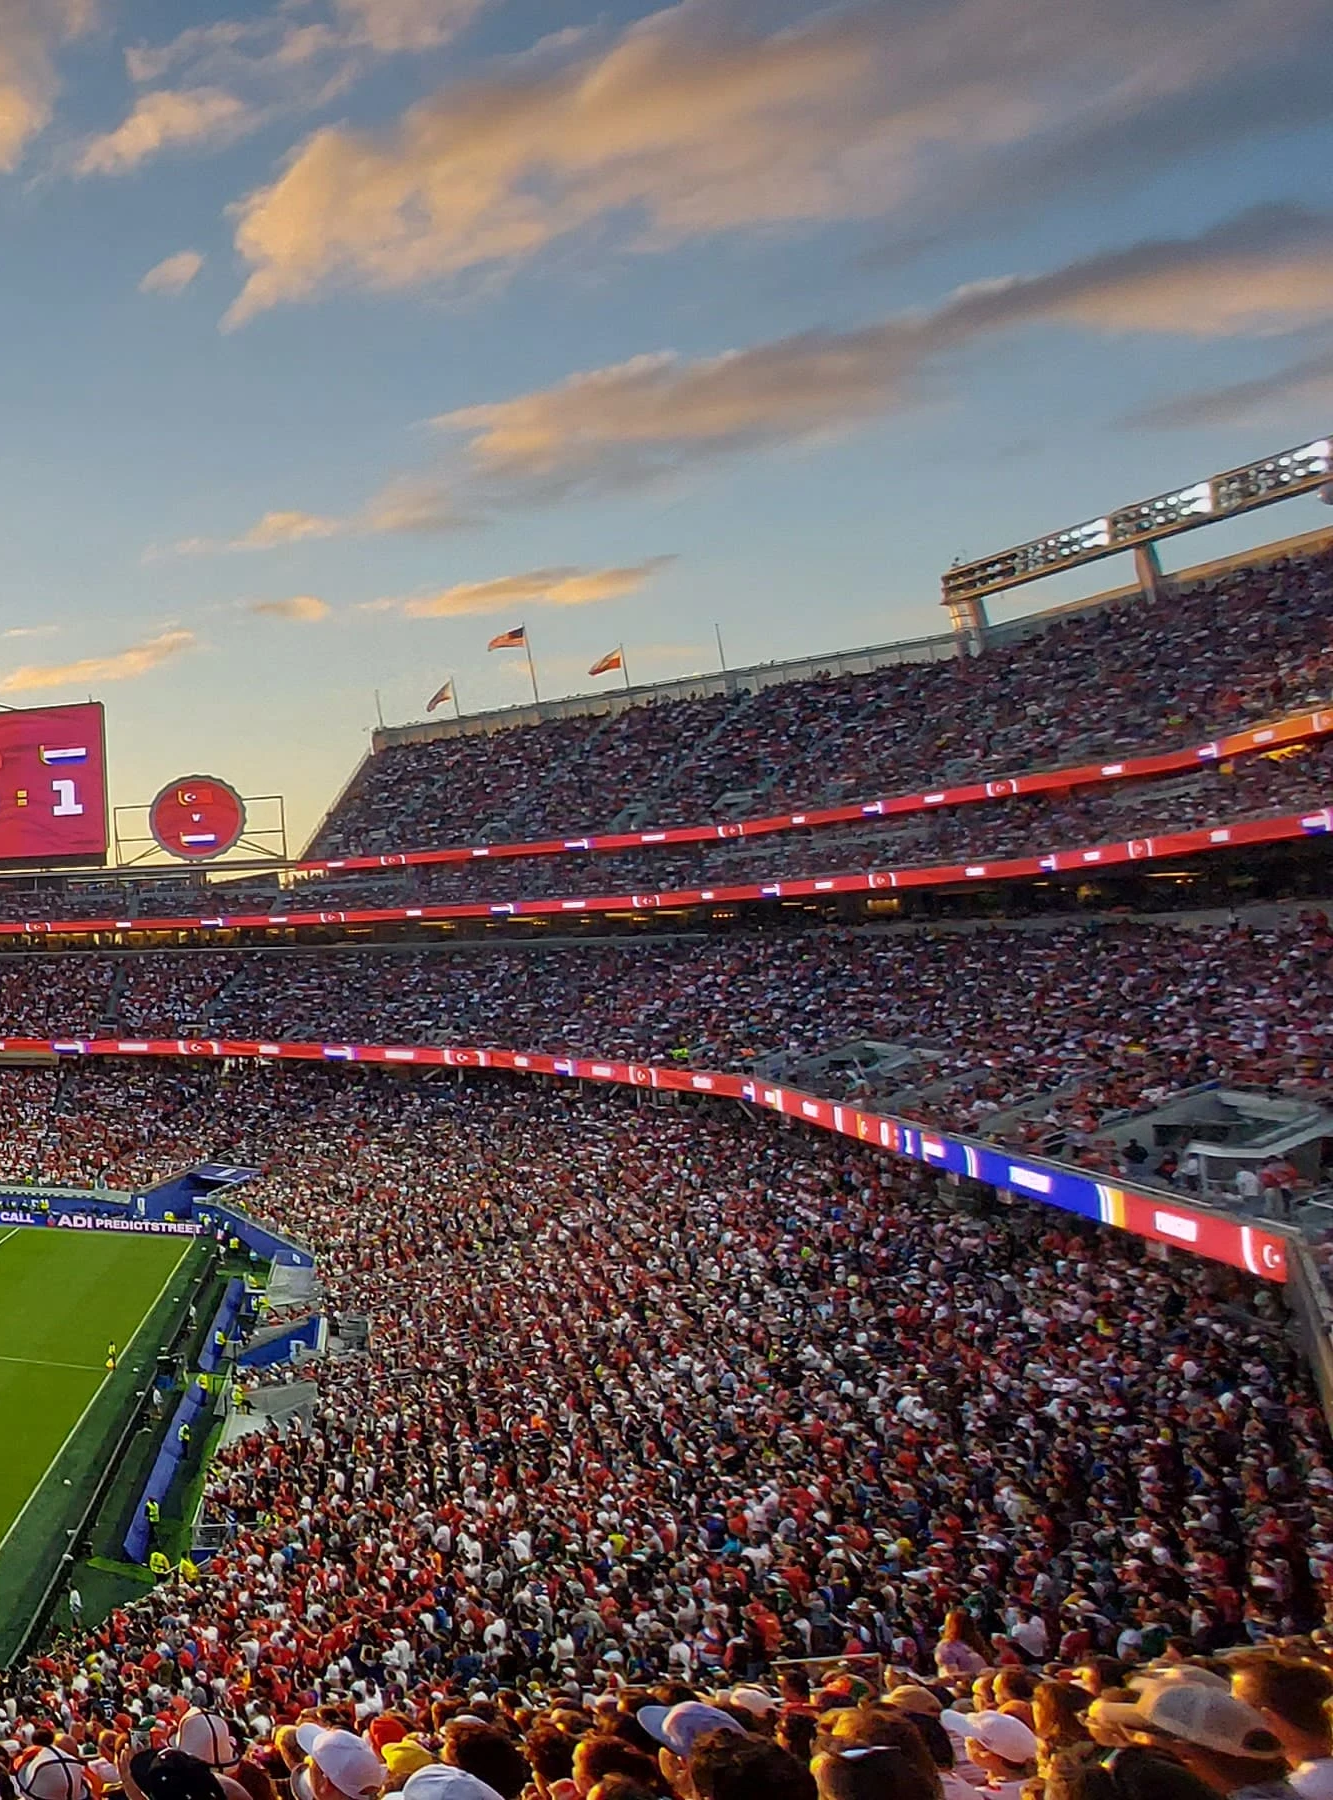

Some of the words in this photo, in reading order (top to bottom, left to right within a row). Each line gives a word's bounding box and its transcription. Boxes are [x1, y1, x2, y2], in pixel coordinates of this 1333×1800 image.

[52, 779, 84, 817] 1
[0, 1210, 35, 1224] CALL
[58, 1214, 93, 1230] ADI
